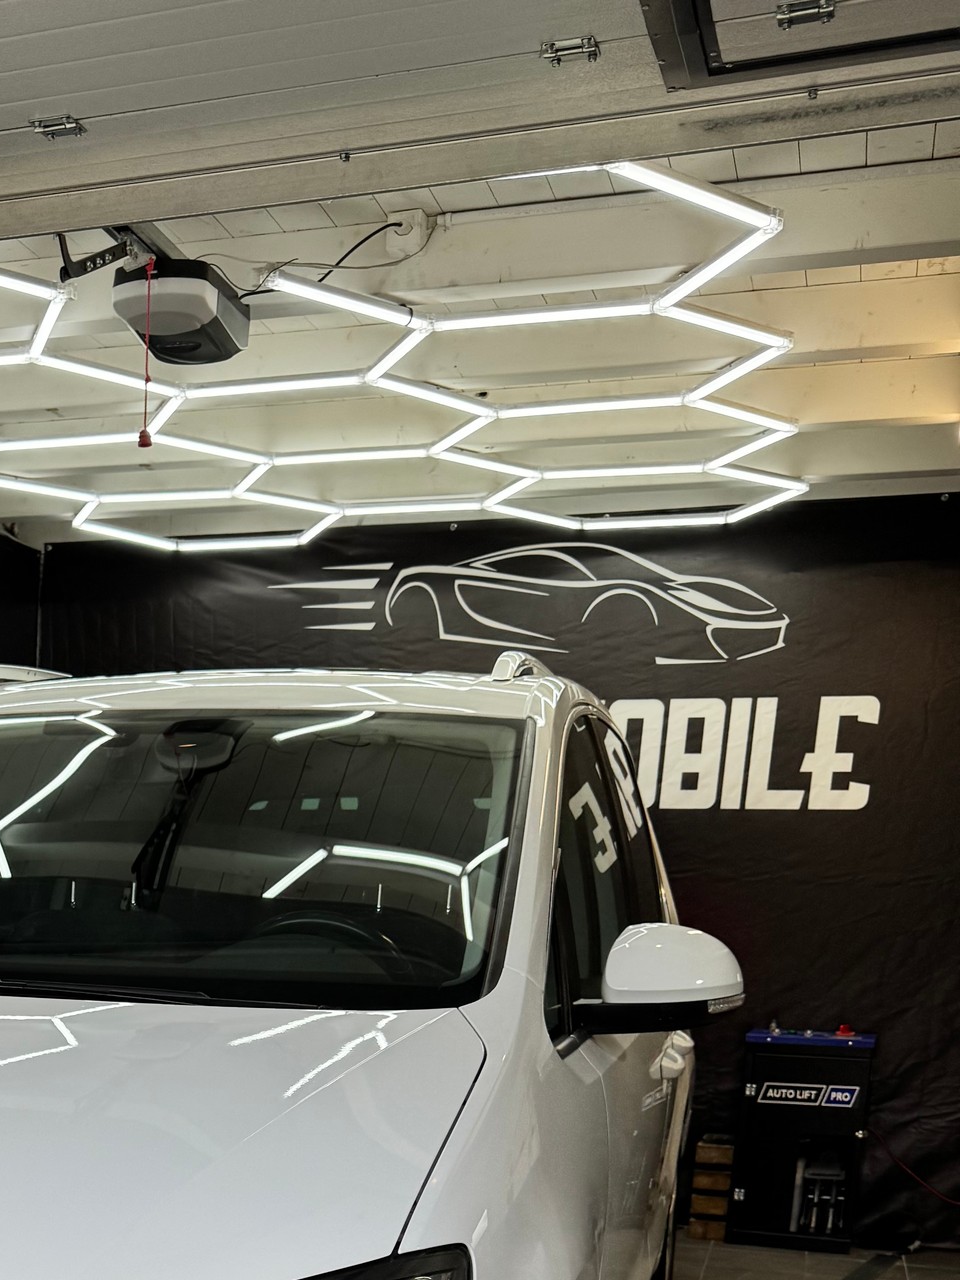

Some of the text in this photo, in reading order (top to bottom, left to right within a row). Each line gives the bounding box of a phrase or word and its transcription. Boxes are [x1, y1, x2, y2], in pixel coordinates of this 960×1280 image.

[599, 695, 881, 811] OBILE
[766, 1088, 851, 1102] AUTO LIFT PRO
